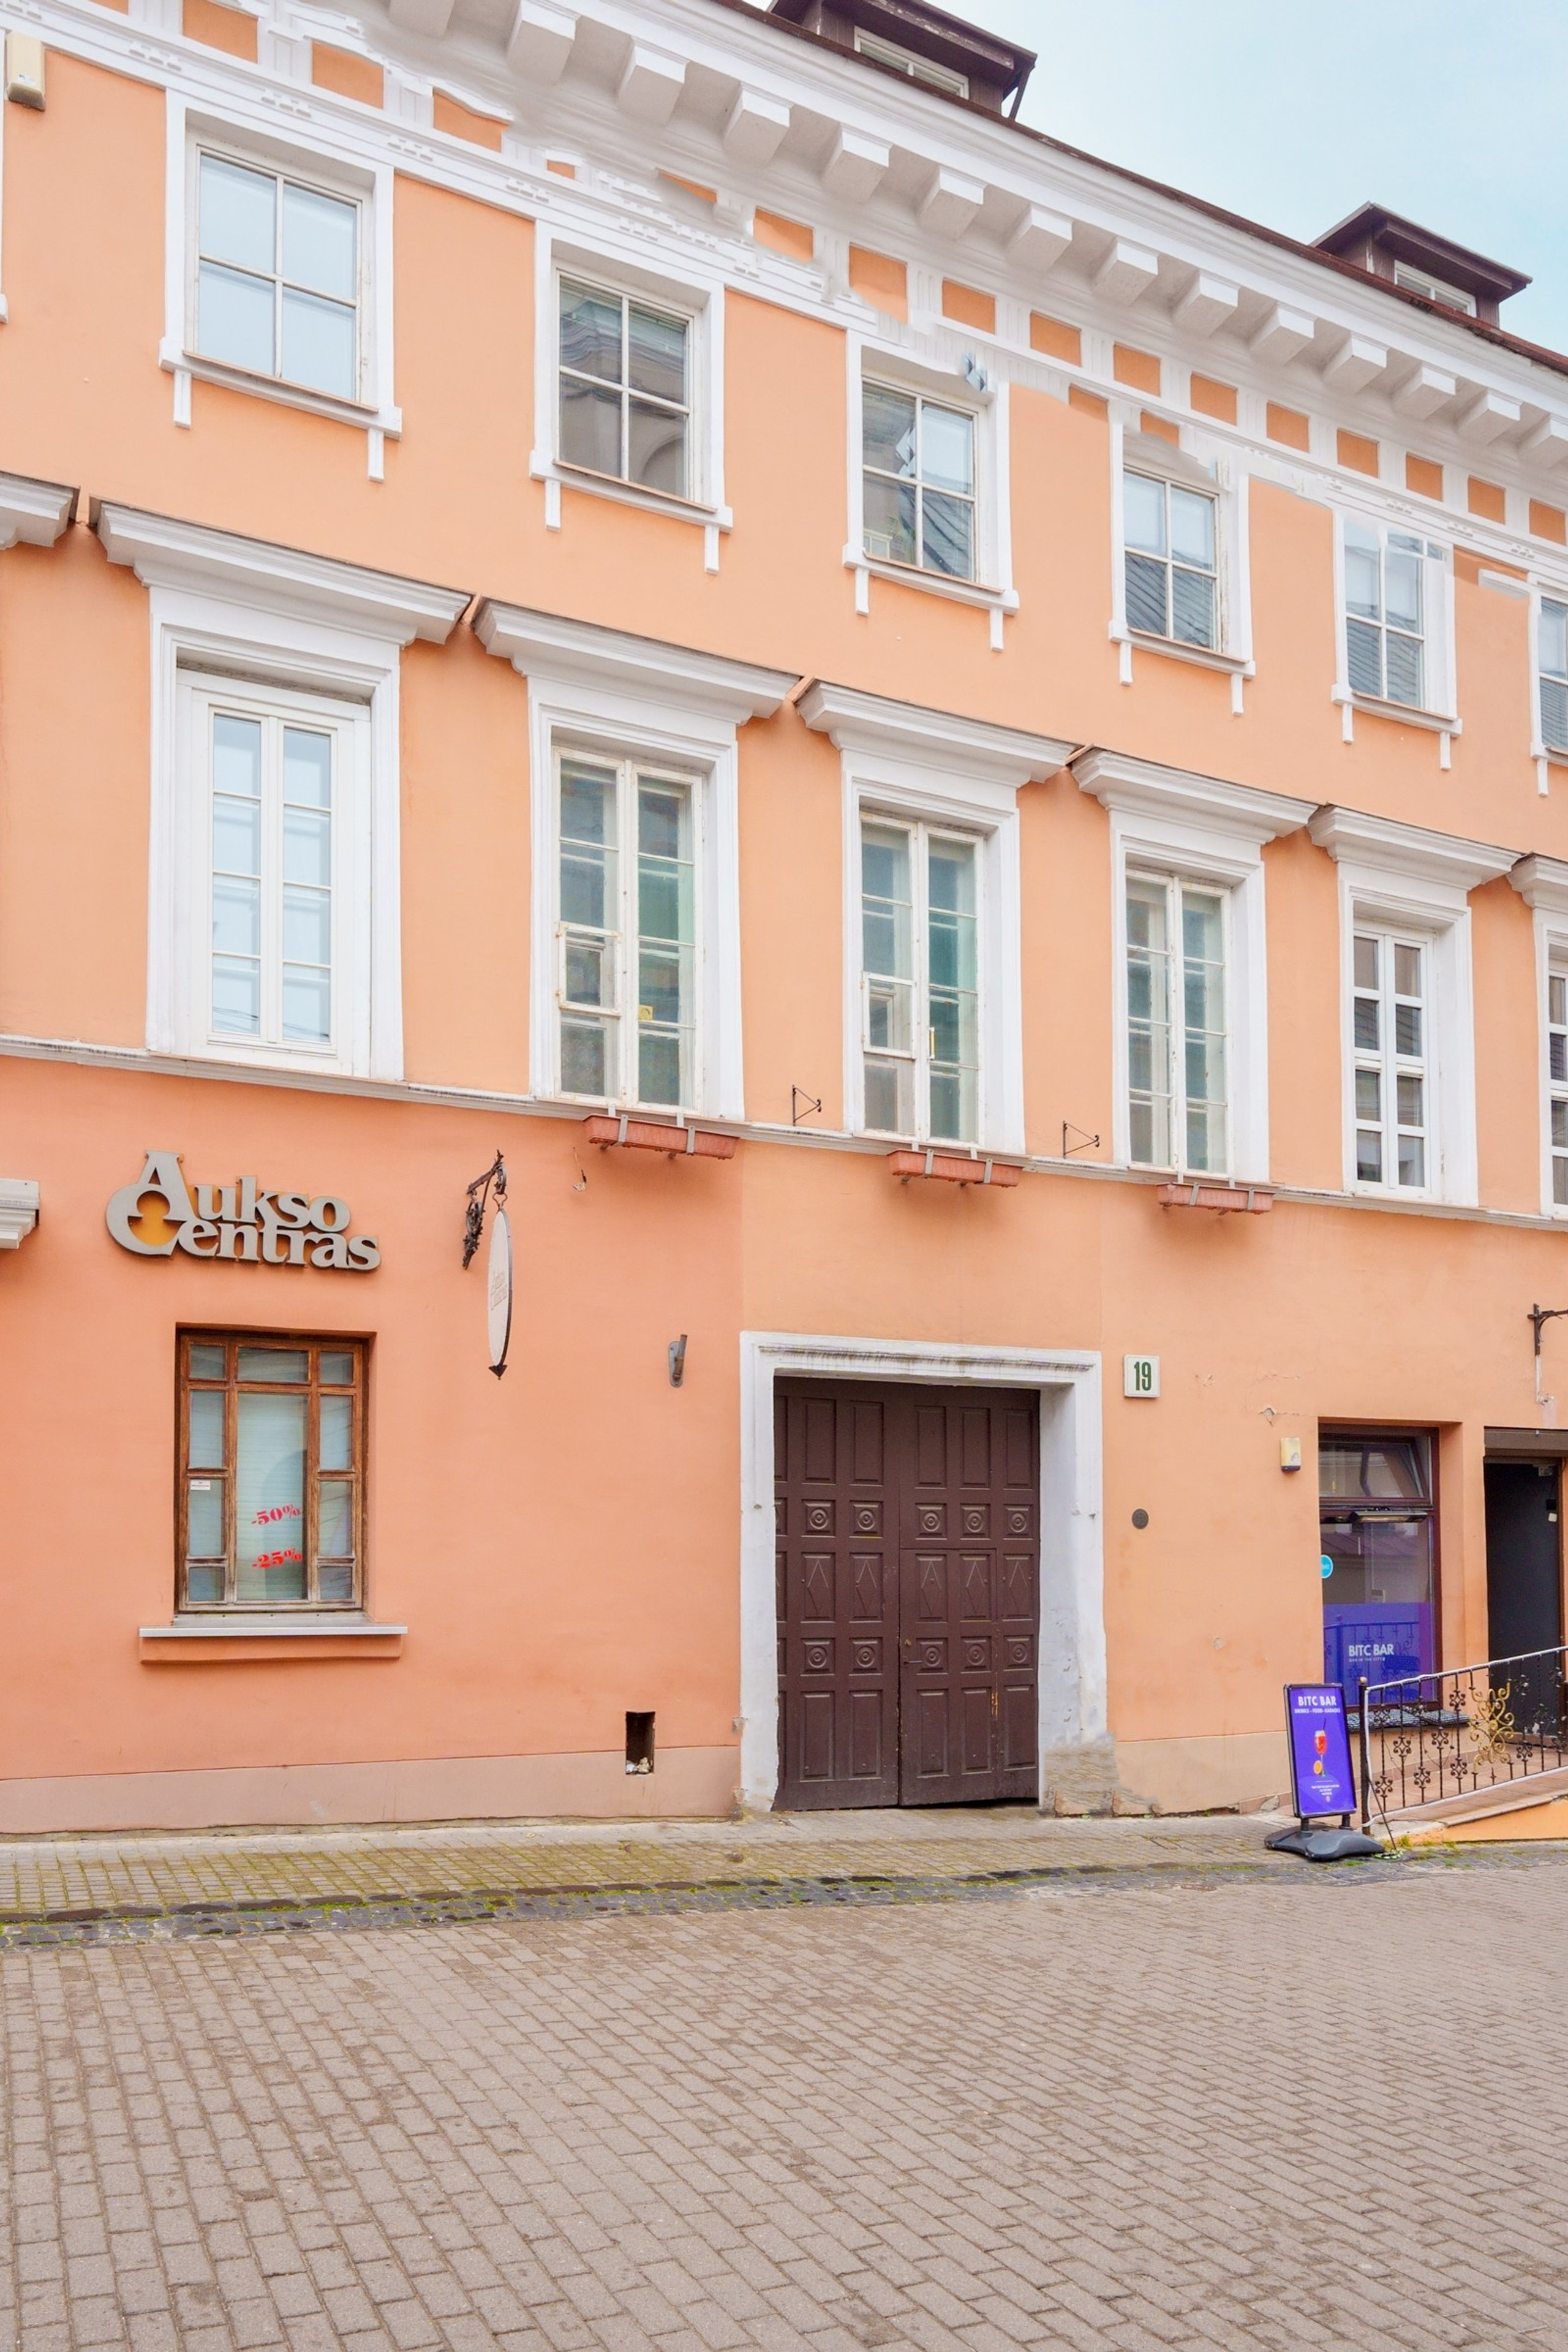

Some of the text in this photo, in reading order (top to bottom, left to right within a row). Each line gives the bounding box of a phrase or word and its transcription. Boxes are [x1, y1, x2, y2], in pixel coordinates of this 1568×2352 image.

[127, 1149, 351, 1233] Aukso
[105, 1182, 382, 1271] Centras
[1134, 1361, 1152, 1391] 19
[252, 1504, 300, 1525] -50%
[252, 1548, 303, 1568] -25%
[1349, 1643, 1395, 1657] BITC BAR
[1298, 1695, 1337, 1706] BITC BAR
